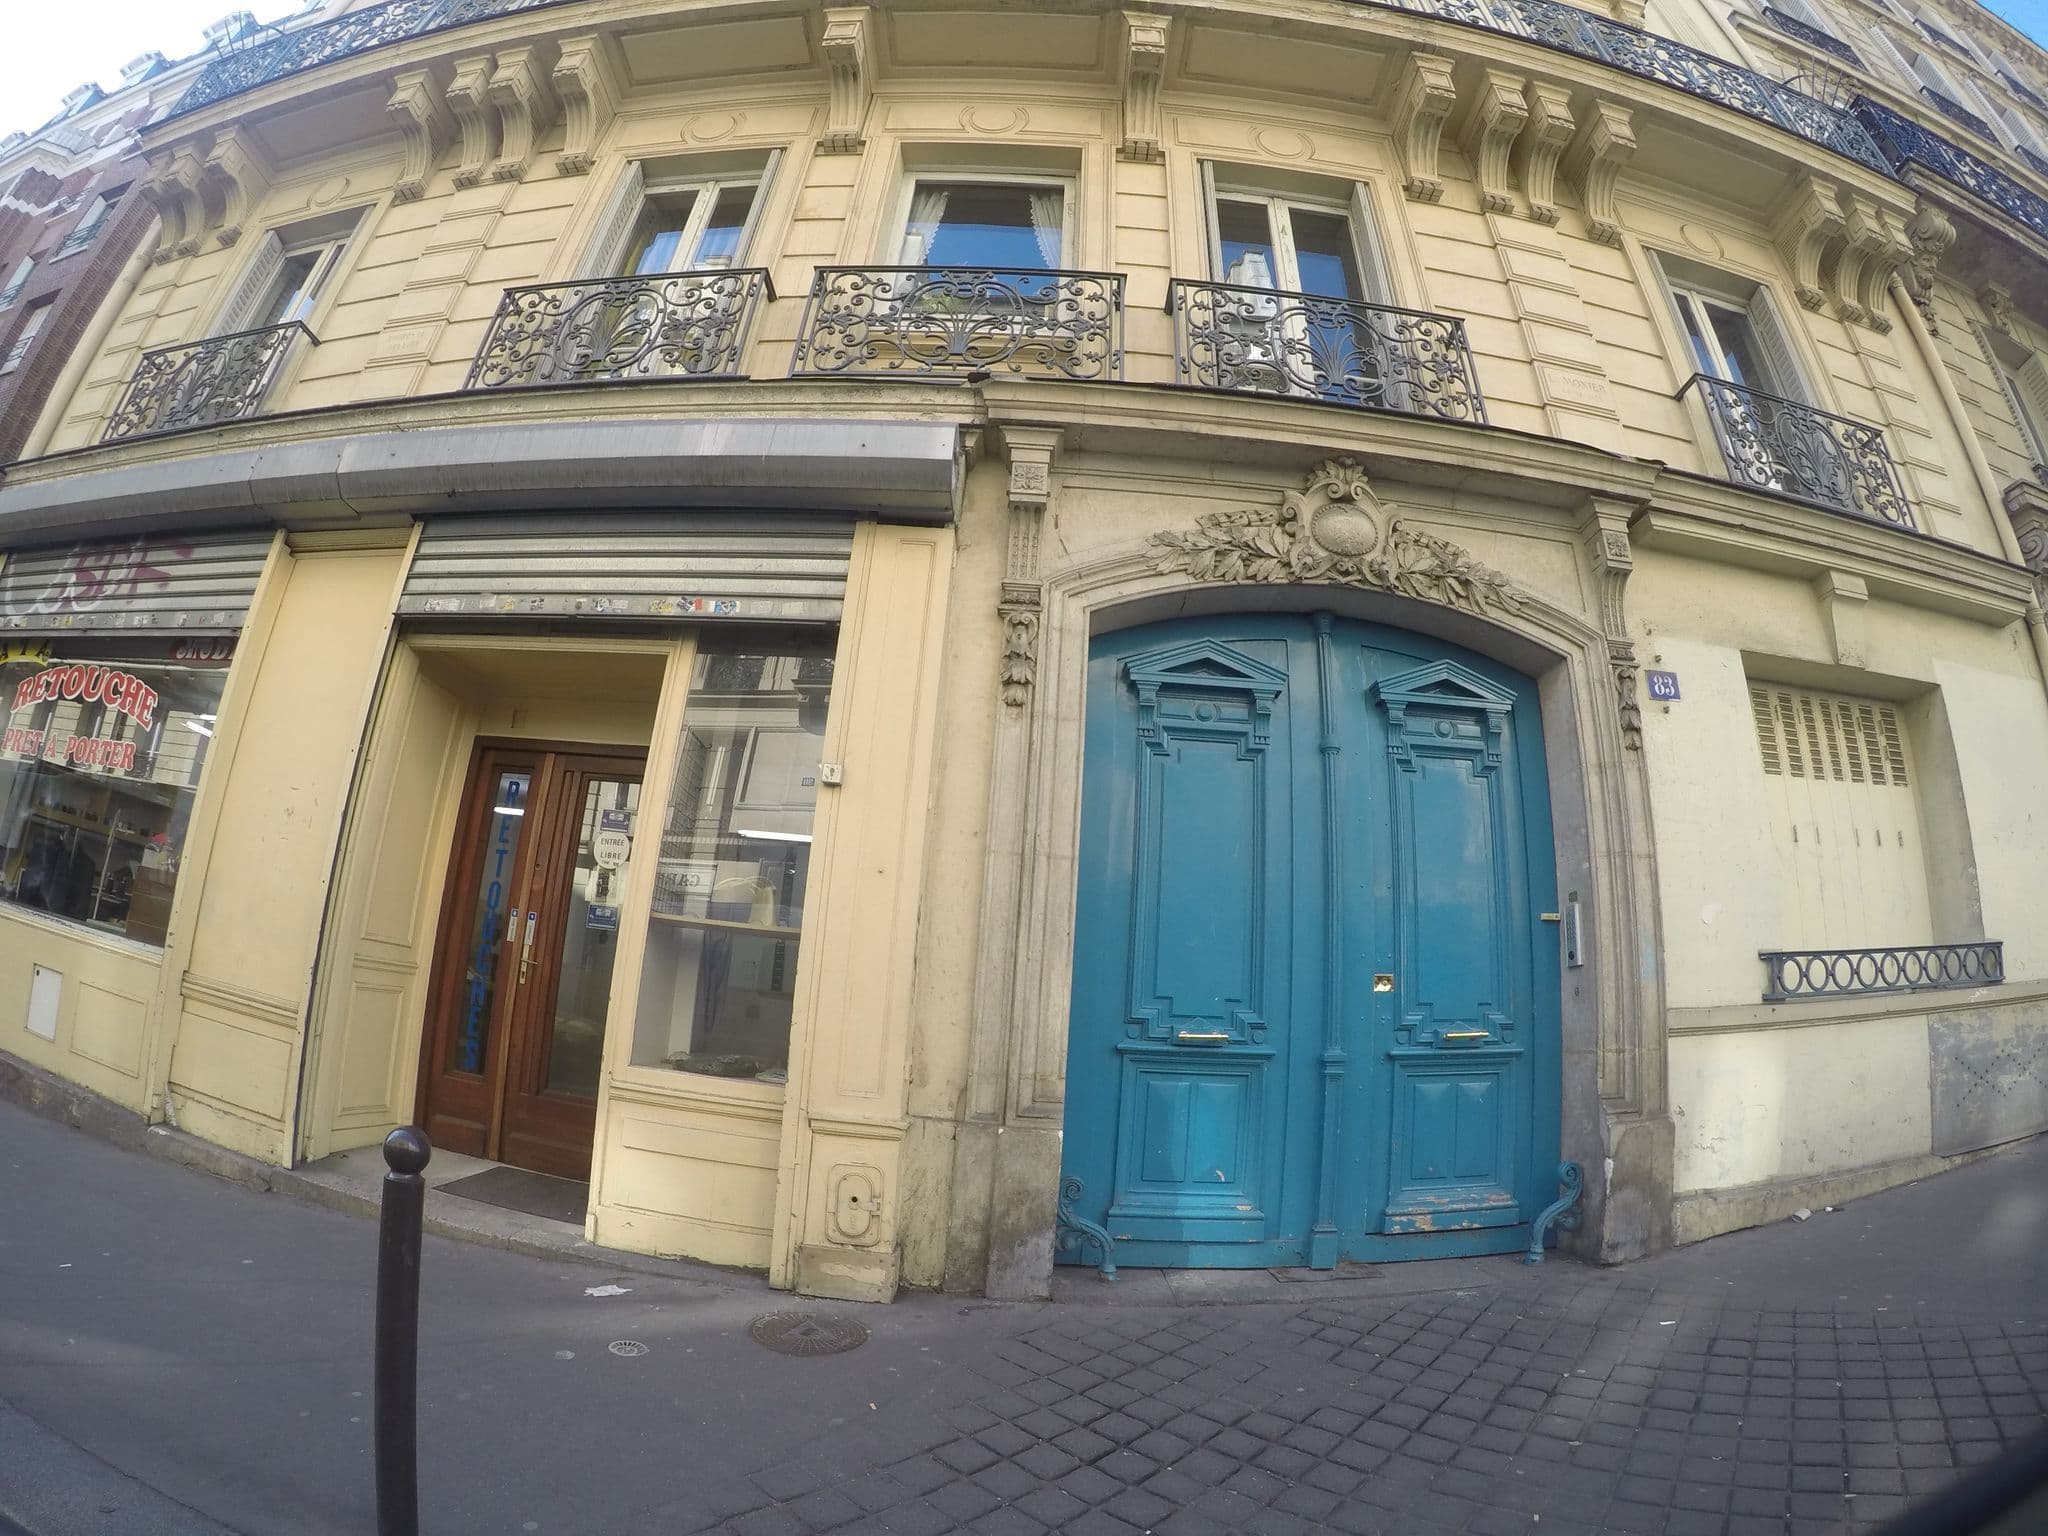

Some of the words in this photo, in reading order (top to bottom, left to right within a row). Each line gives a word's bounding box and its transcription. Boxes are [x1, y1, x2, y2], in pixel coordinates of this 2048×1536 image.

[10, 664, 158, 732] RETOUCHE
[1653, 675, 1675, 697] 83
[1, 727, 44, 756] PRET
[42, 733, 57, 760] A
[63, 735, 137, 771] PORTER
[600, 852, 622, 861] LIBRE
